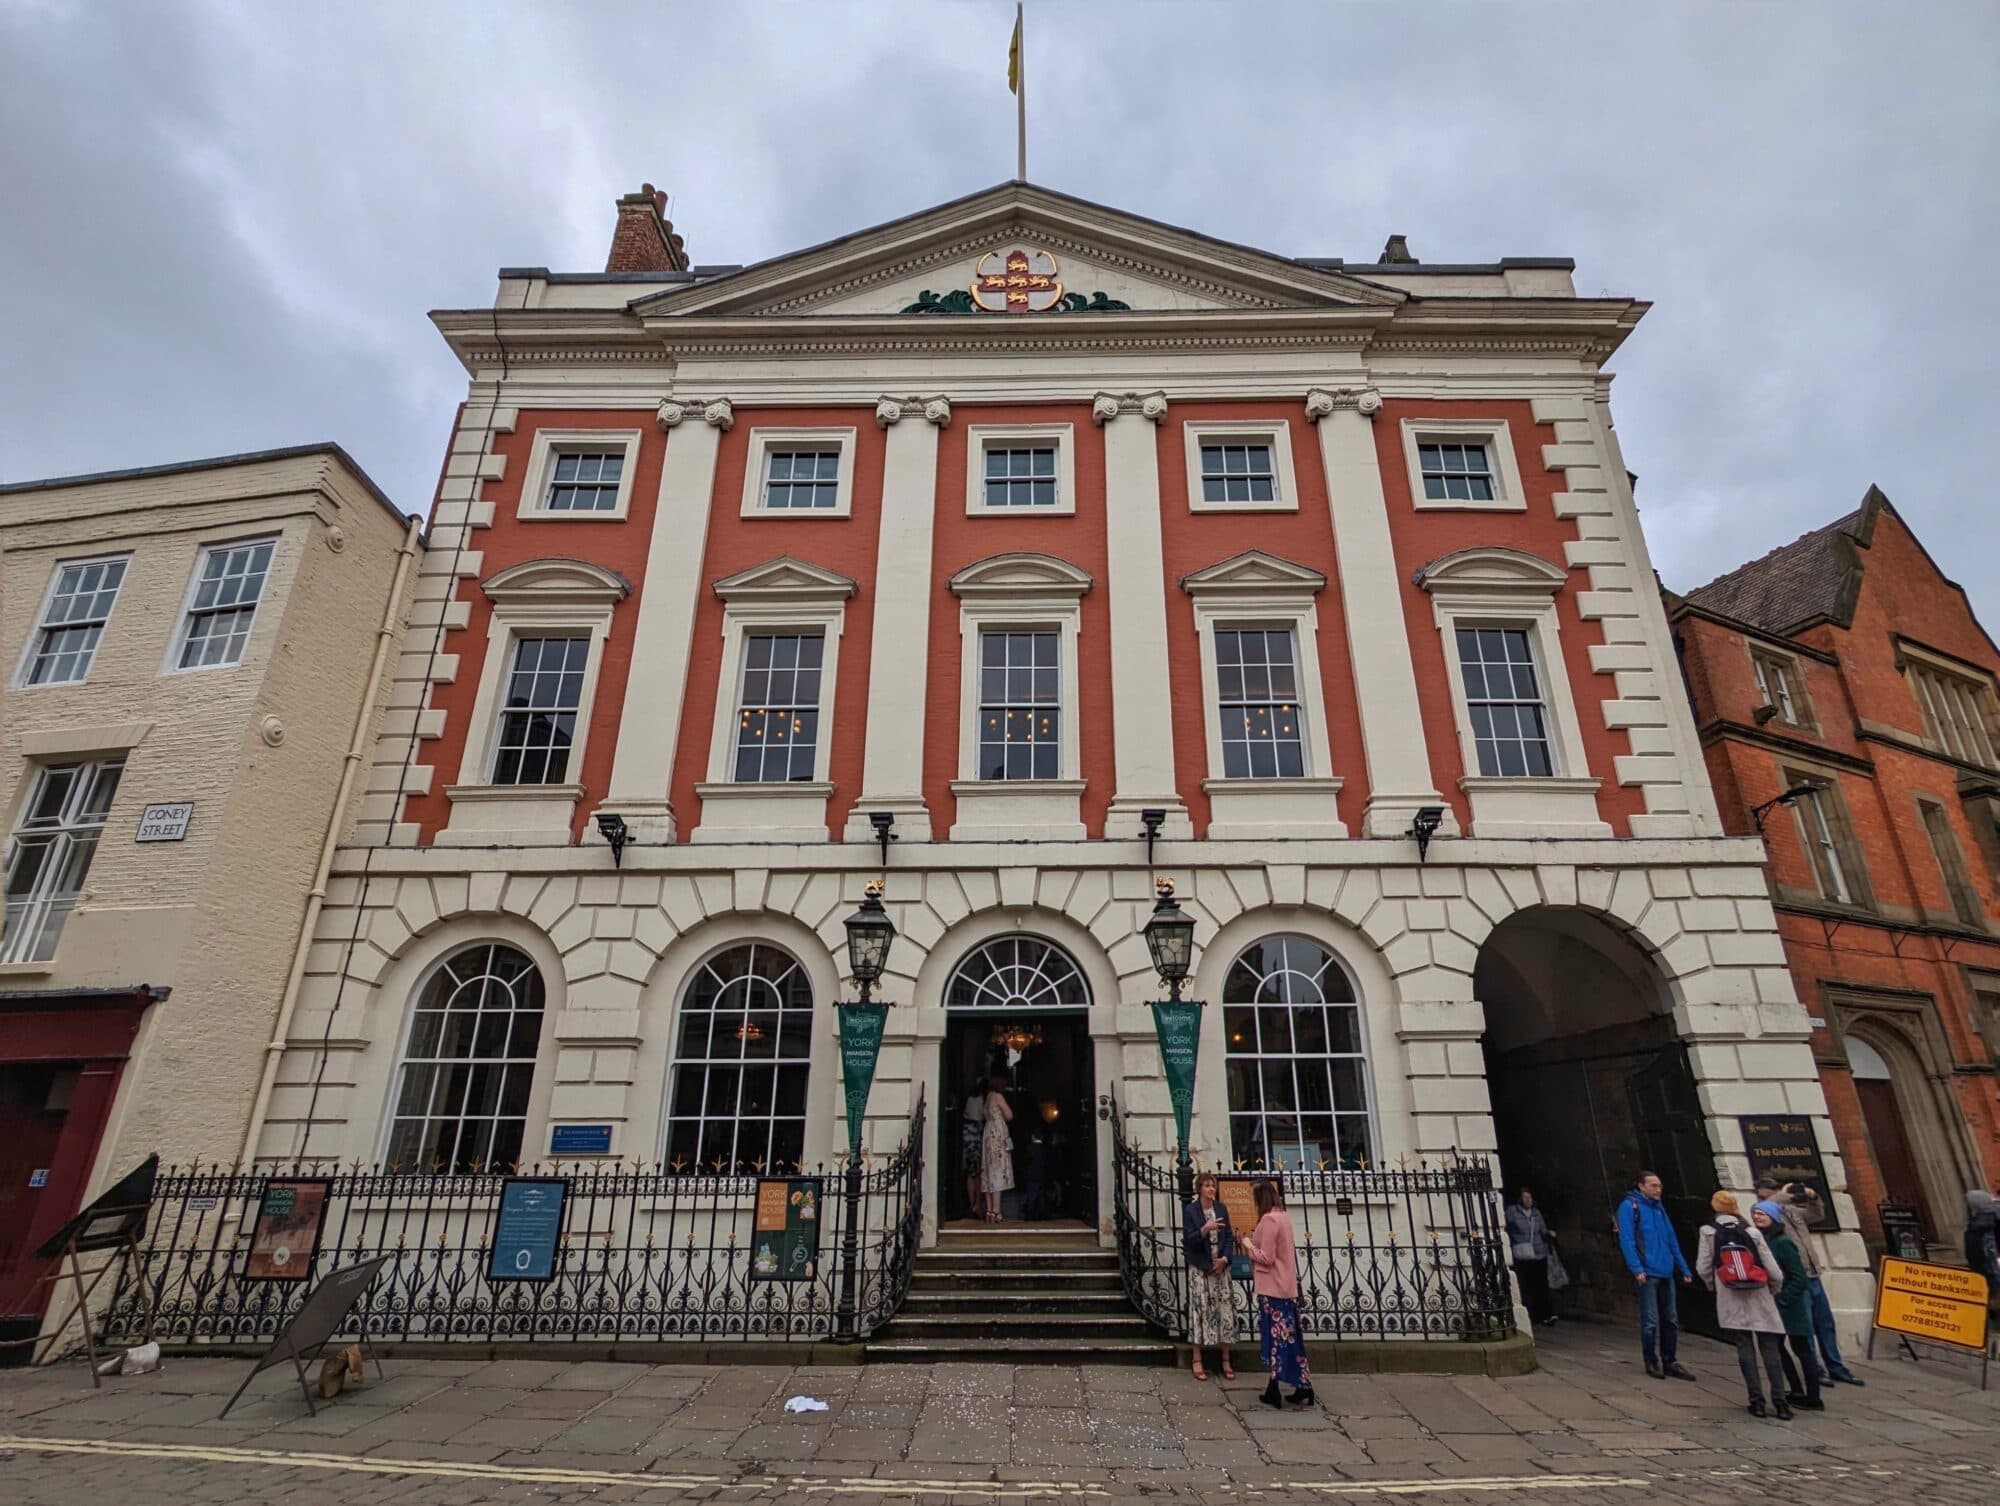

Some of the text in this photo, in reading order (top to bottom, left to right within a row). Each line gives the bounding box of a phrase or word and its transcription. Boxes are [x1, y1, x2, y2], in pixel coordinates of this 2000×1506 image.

[147, 808, 189, 820] CONEY
[141, 823, 183, 836] STREET
[848, 1038, 874, 1047] YORK
[1166, 1036, 1192, 1045] YORK
[846, 1059, 873, 1067] HOUSE
[1166, 1057, 1193, 1065] HOUSE
[1753, 1146, 1812, 1157] The Guildhall
[271, 1189, 295, 1198] YORK
[763, 1189, 786, 1199] YORK
[1225, 1187, 1249, 1196] YORK
[1904, 1265, 1969, 1285] No reversing
[1890, 1276, 1983, 1297] without banksman
[1910, 1295, 1957, 1311] For access
[1914, 1308, 1949, 1319] contact
